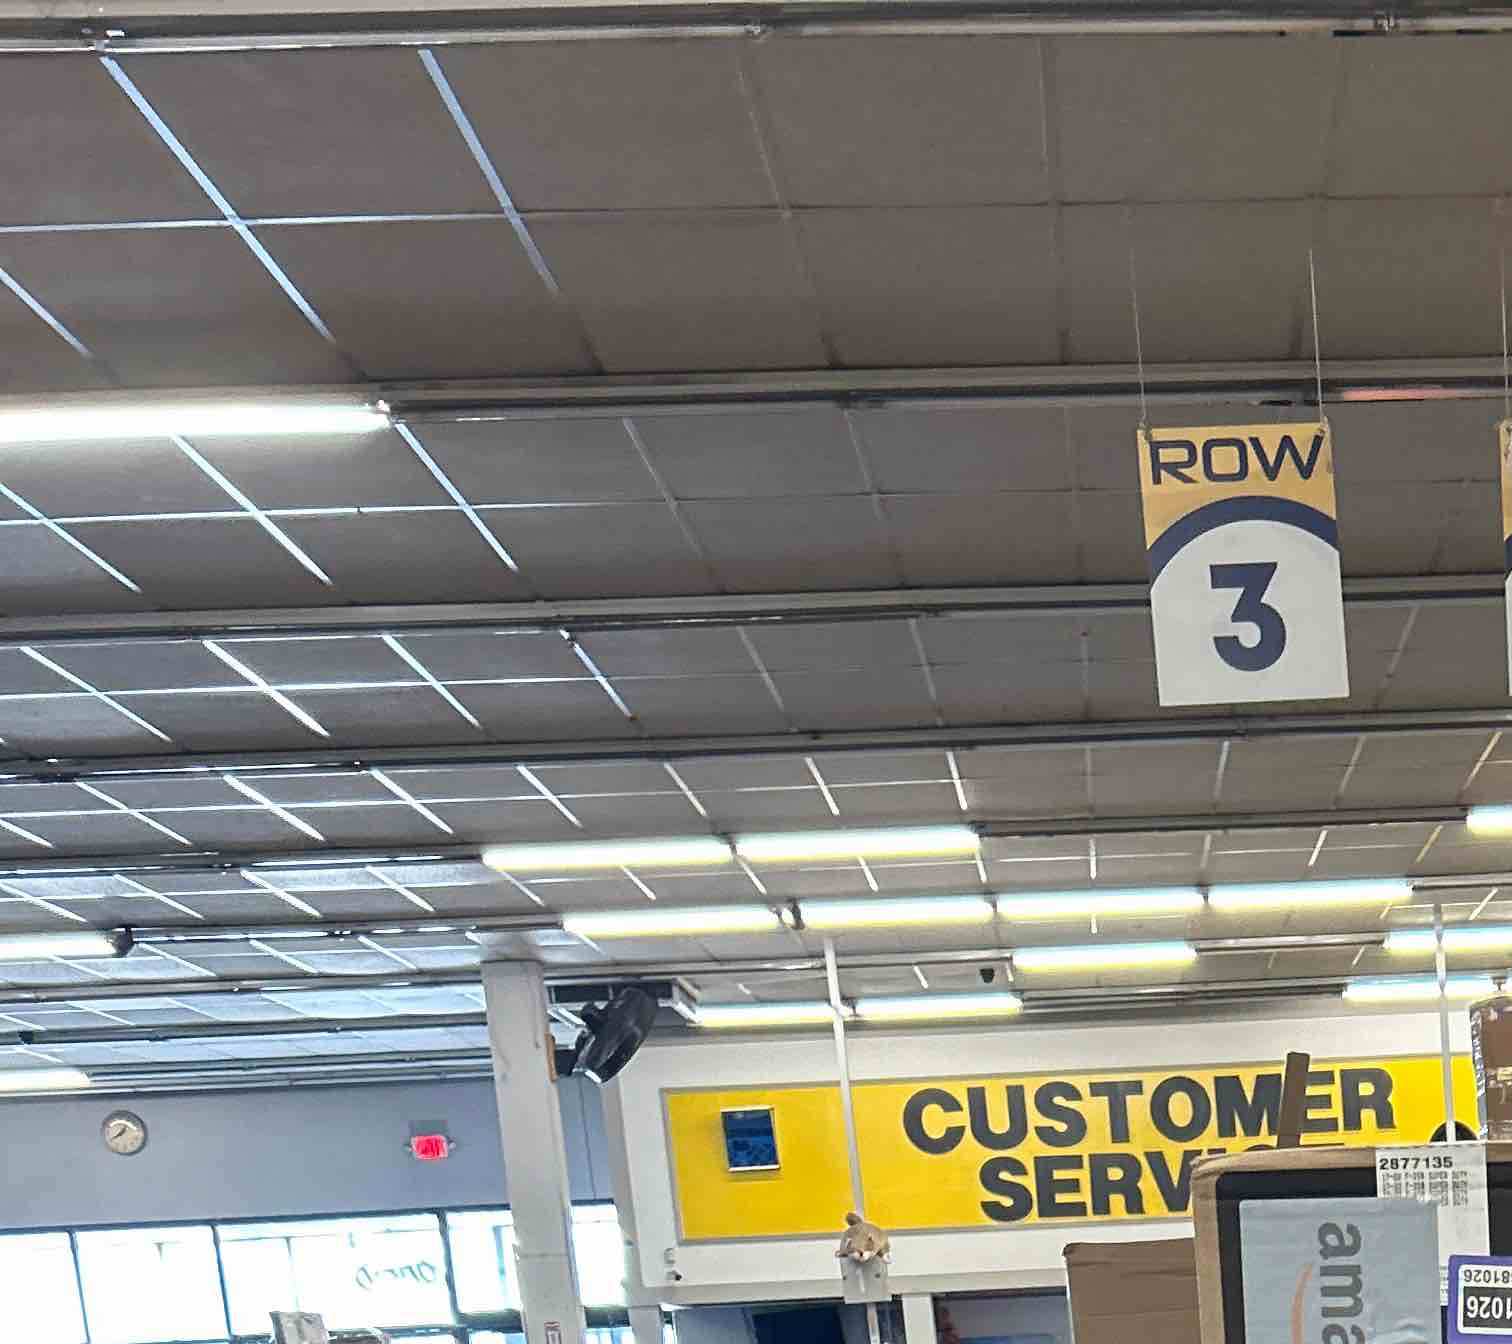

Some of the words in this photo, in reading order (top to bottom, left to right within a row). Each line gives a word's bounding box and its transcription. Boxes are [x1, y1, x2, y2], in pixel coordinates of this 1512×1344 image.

[1149, 433, 1324, 485] ROW
[1212, 562, 1287, 672] 3
[902, 1066, 1397, 1155] CUSTOMER
[979, 1143, 1225, 1222] SERV
[1377, 1155, 1455, 1171] 2877135
